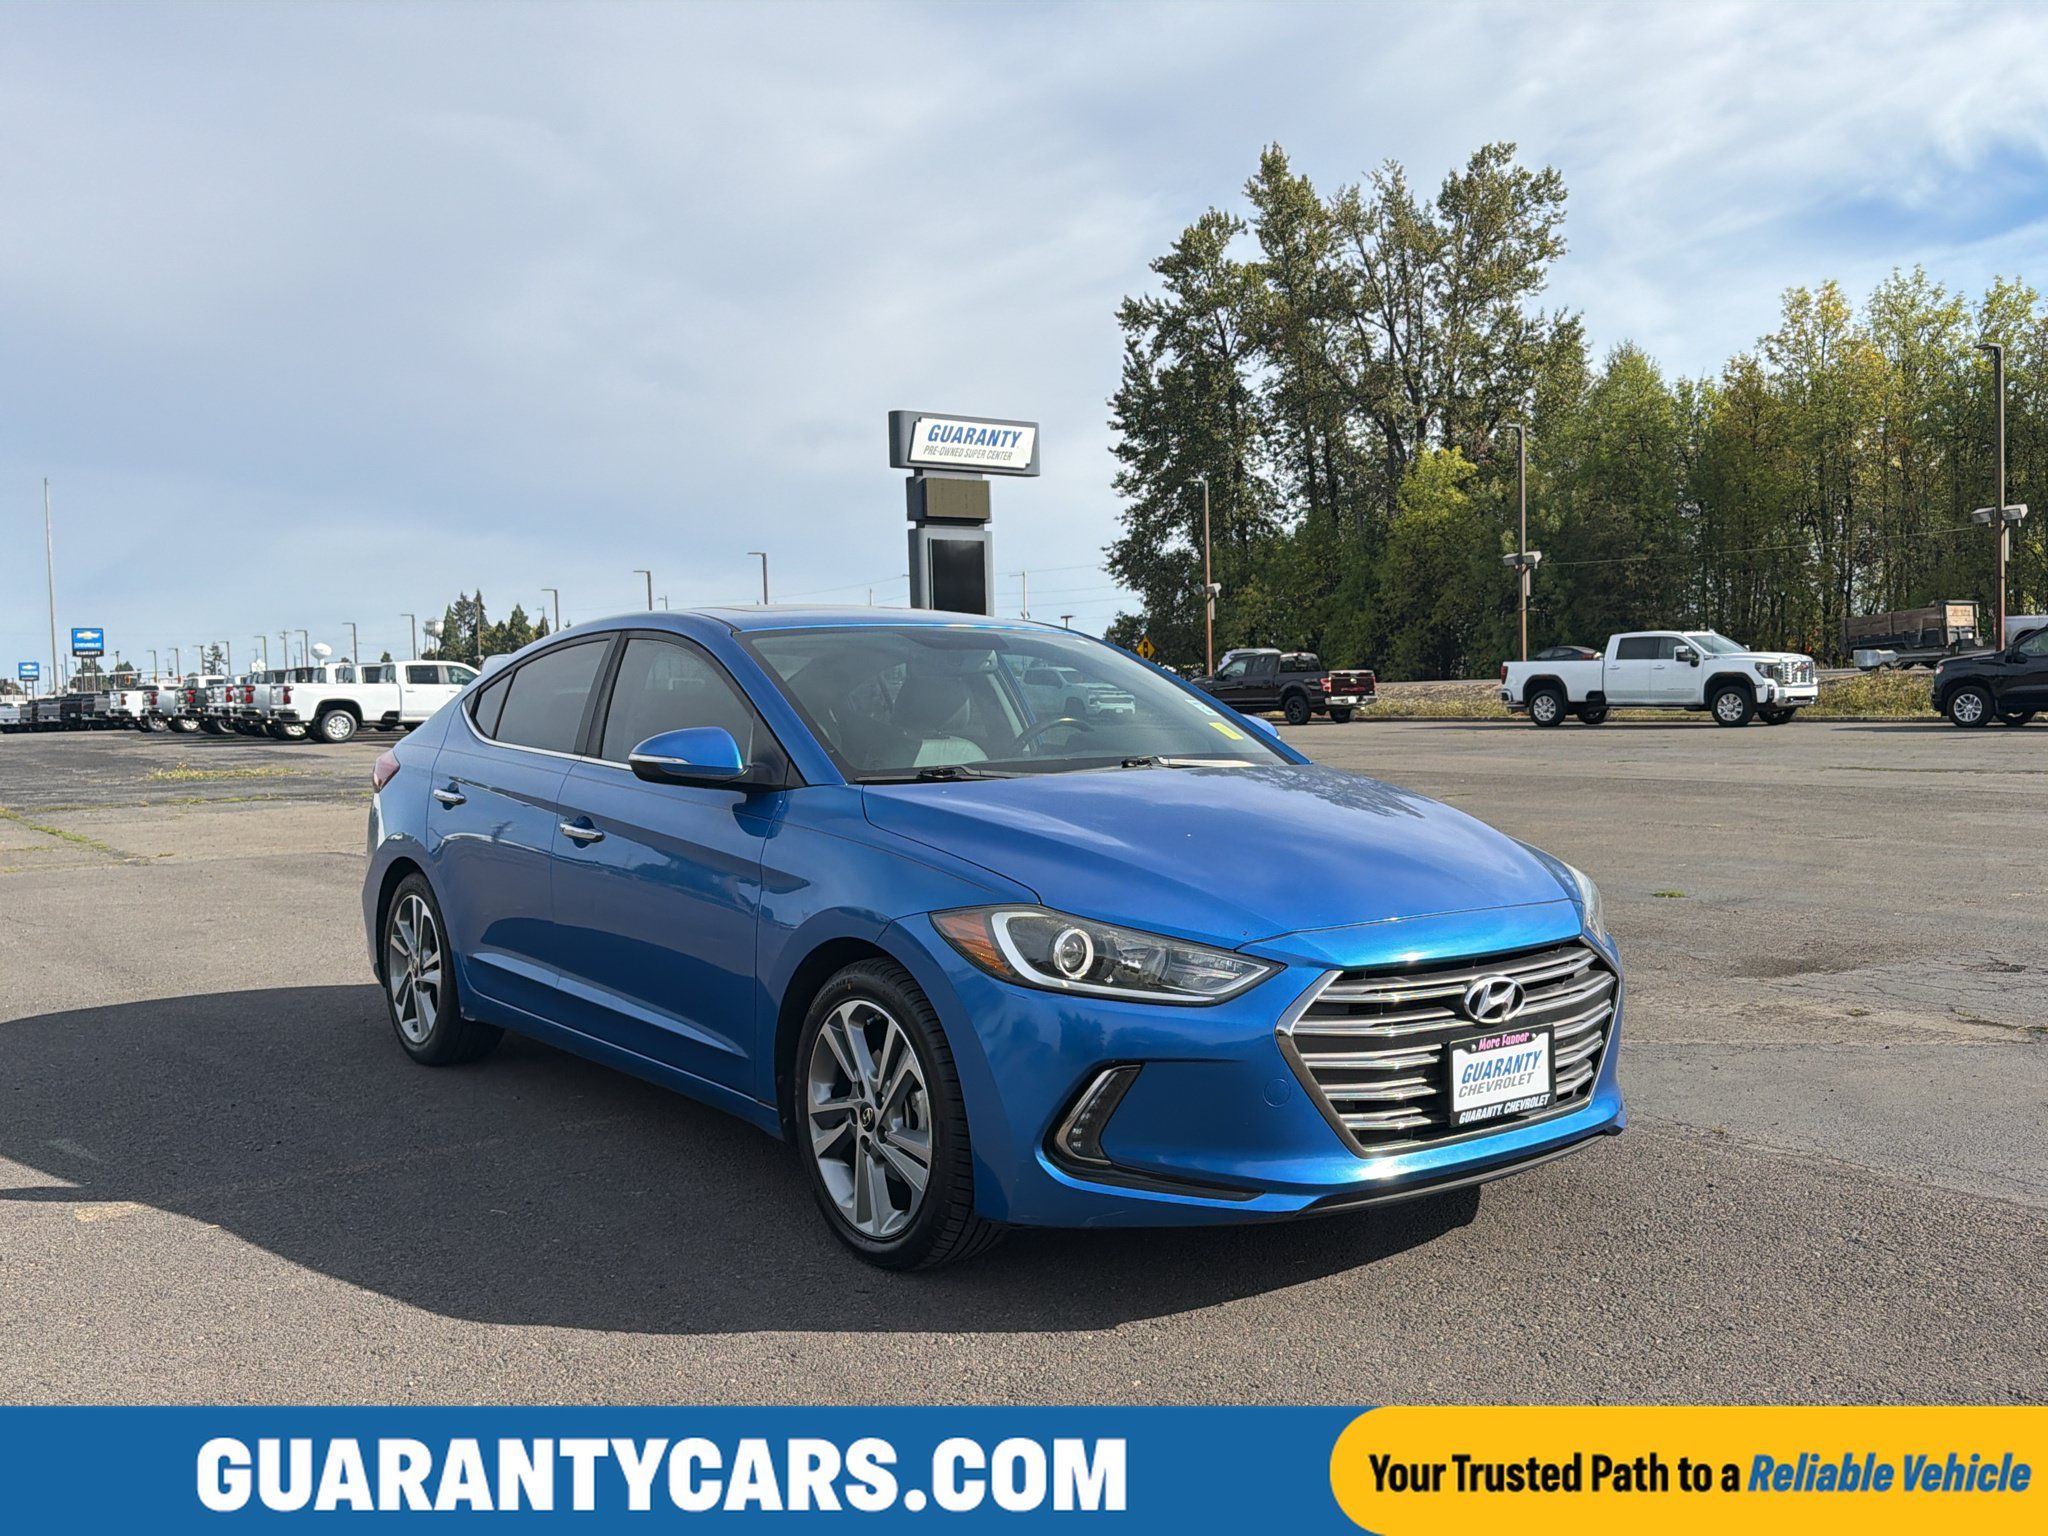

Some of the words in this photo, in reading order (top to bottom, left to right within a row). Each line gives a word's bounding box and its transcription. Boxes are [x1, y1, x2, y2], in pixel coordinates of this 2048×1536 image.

[927, 424, 1023, 448] GUARANTY
[923, 445, 964, 457] PRE-OWNED
[964, 448, 986, 459] SUPER
[986, 450, 1013, 461] CENTER
[1478, 1037, 1501, 1051] More
[1461, 1050, 1543, 1085] GUARANTY
[1458, 1072, 1534, 1098] CHEVROLET
[1458, 1103, 1503, 1125] GUARANTY
[1504, 1093, 1551, 1115] CHEVROLET
